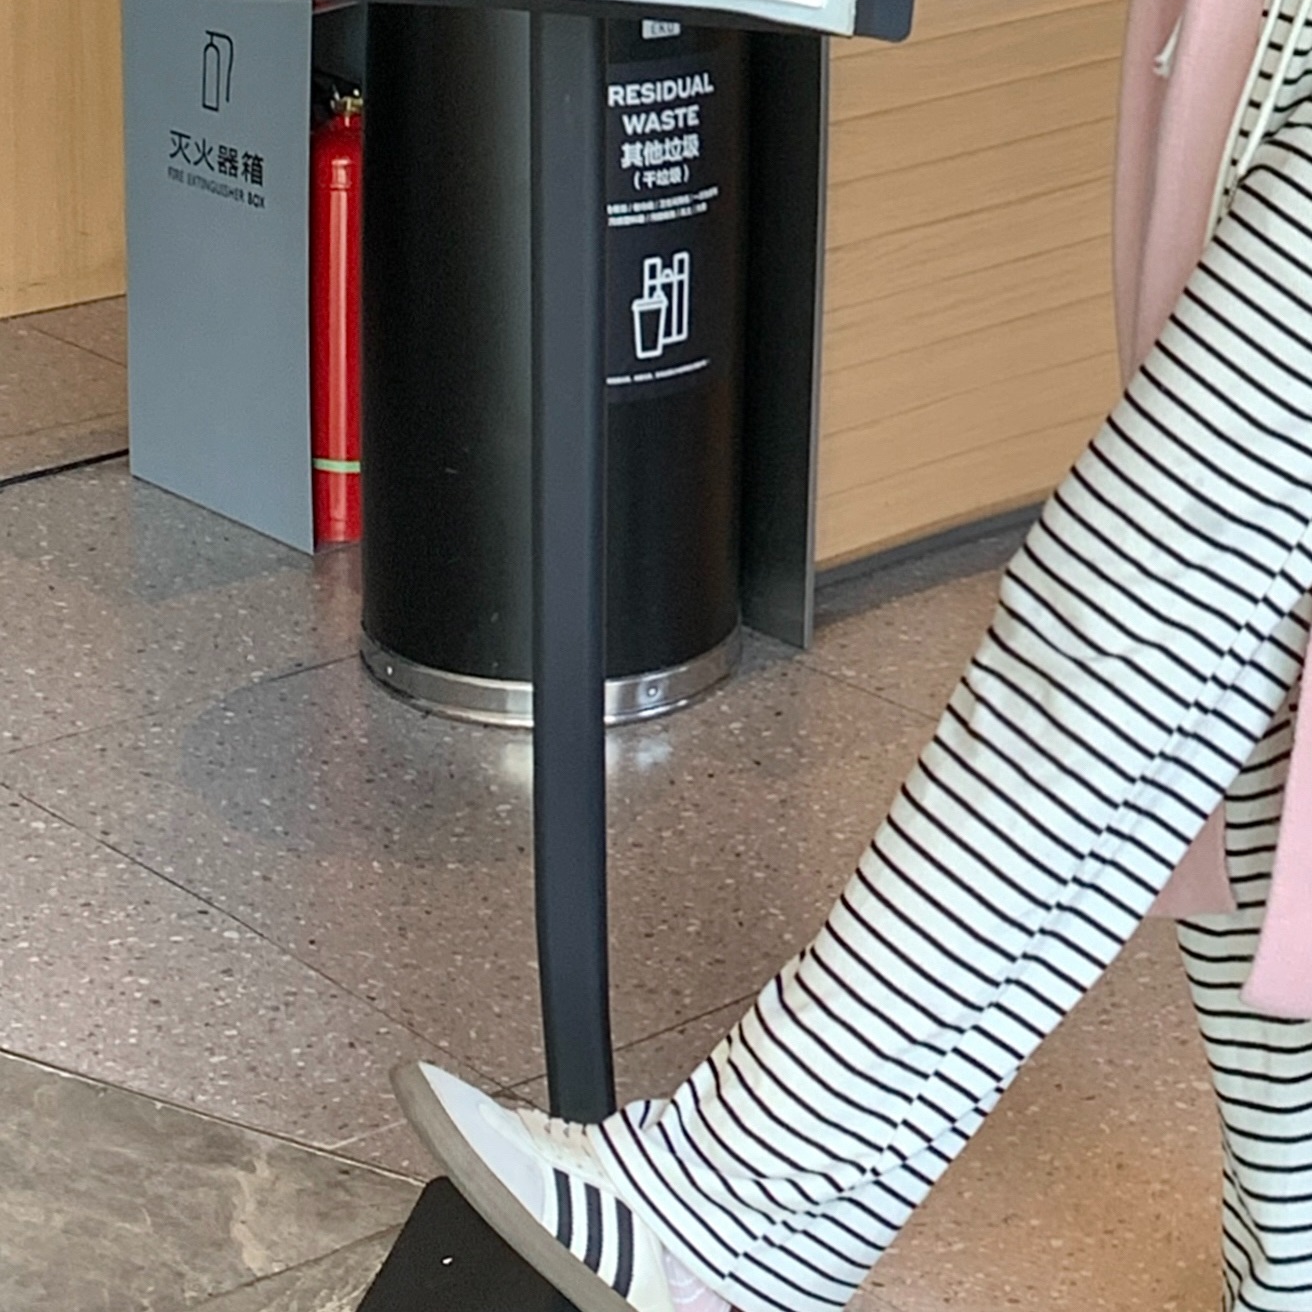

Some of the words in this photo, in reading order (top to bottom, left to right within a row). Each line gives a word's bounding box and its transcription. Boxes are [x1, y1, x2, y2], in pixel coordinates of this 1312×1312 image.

[608, 72, 715, 107] RESIDUAL
[621, 104, 700, 136] WASTE
[168, 129, 265, 188] 灭火器箱
[620, 133, 700, 169] 其他垃圾
[247, 191, 266, 210] BOX
